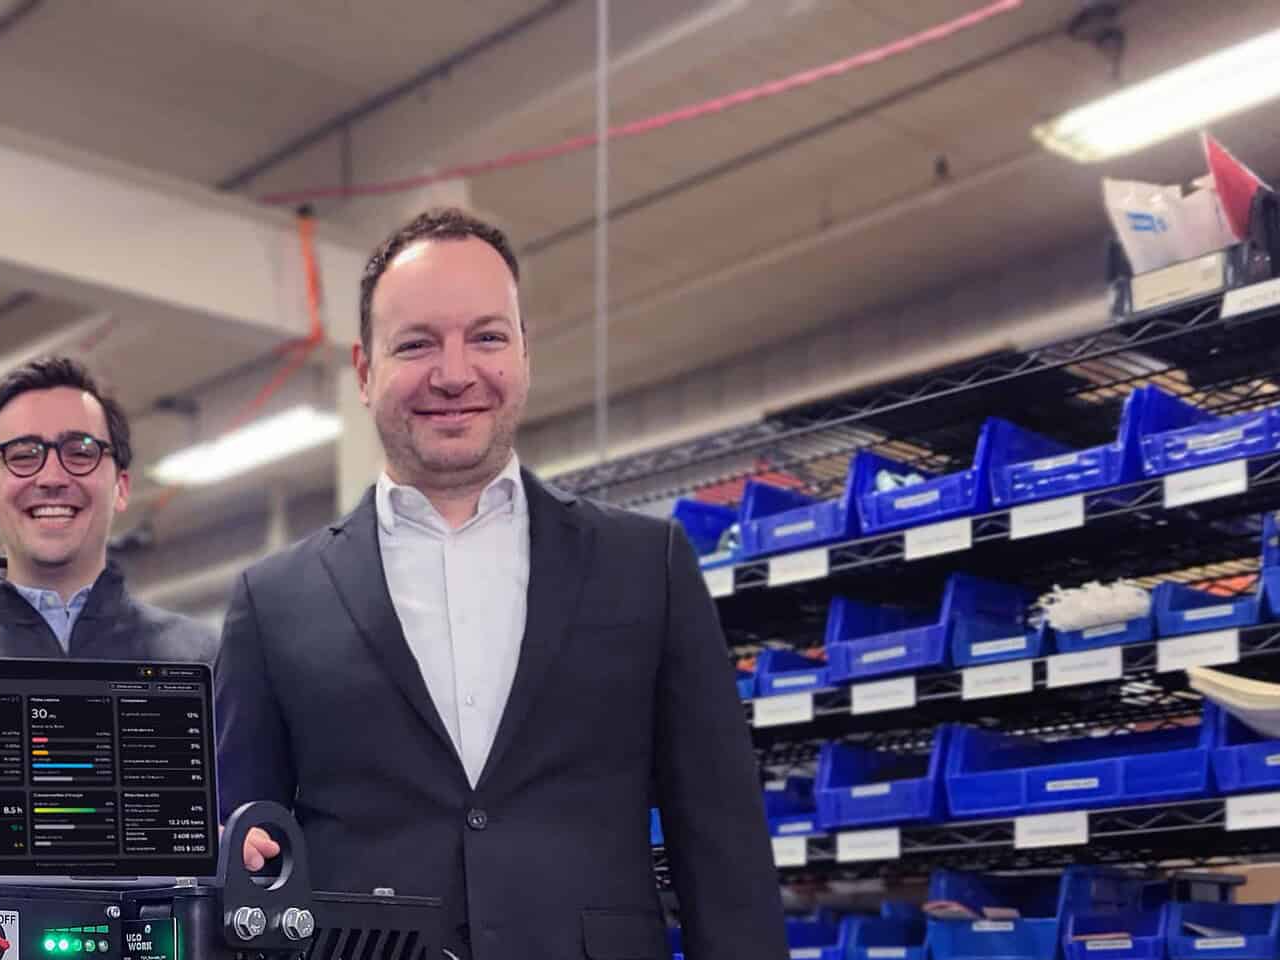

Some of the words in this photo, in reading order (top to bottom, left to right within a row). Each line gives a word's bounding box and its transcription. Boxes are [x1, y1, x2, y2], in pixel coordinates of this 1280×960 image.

[31, 708, 48, 719] 30
[126, 933, 142, 942] UGO
[128, 941, 153, 951] WORK
